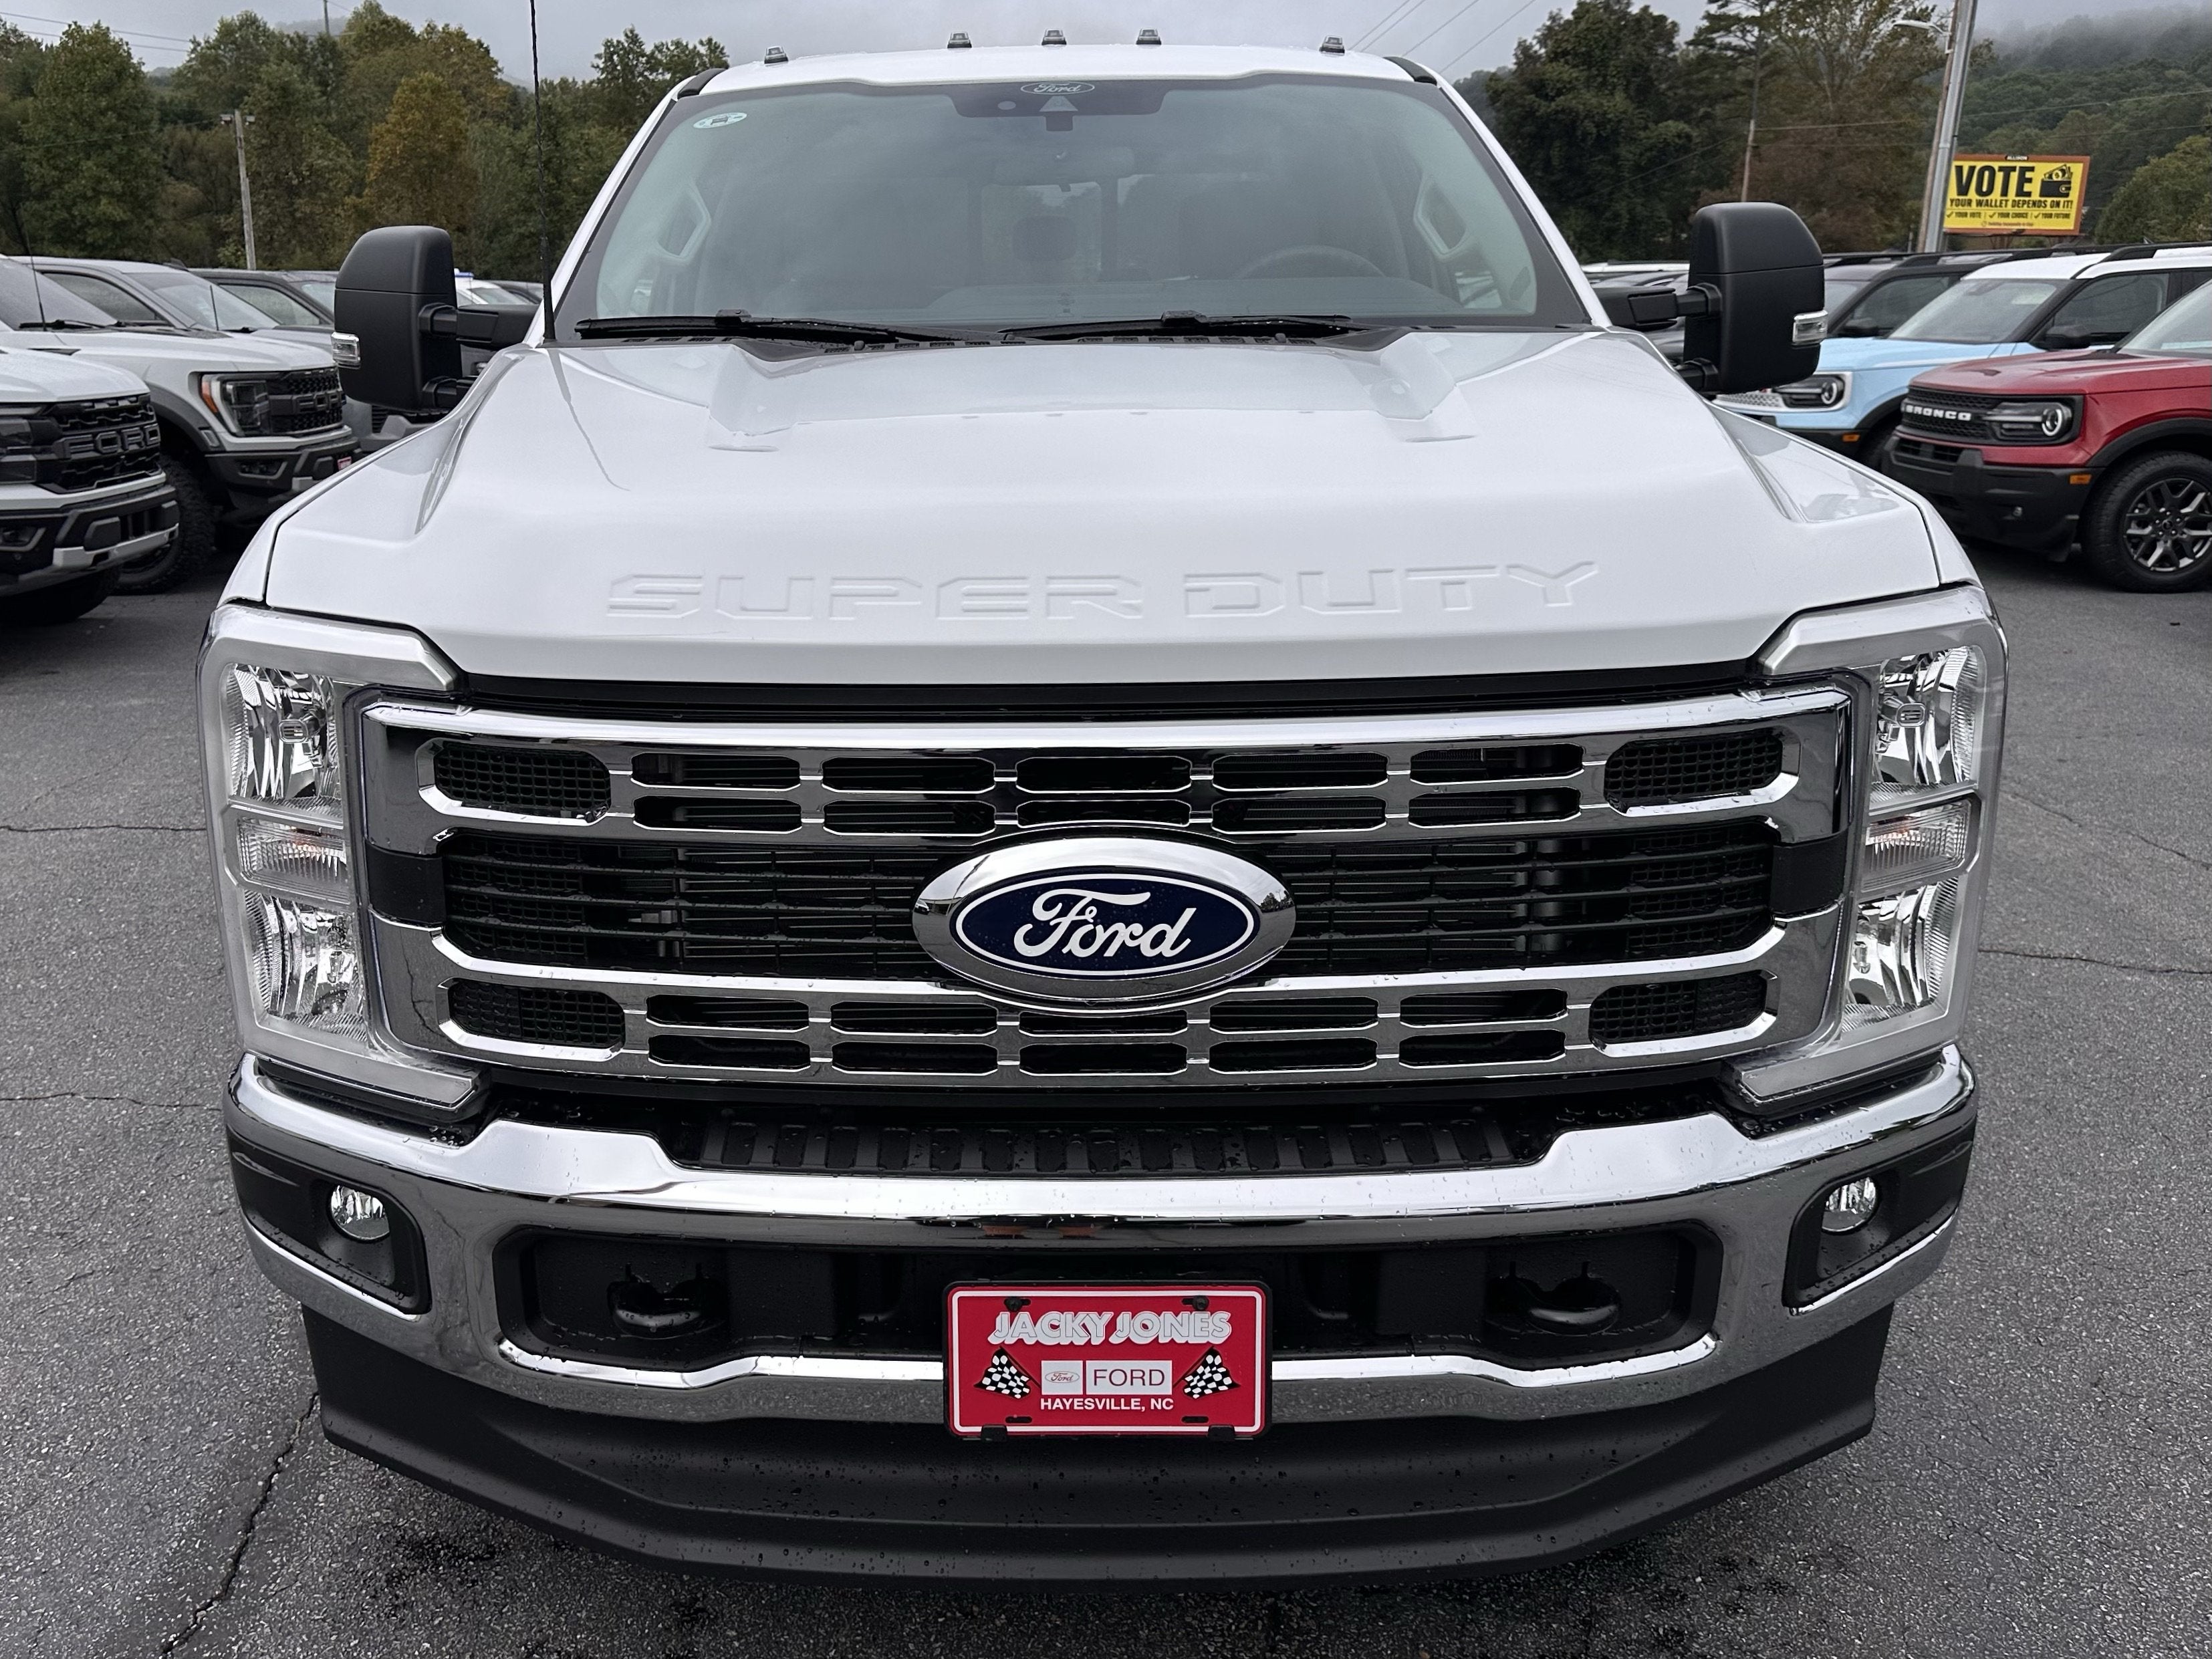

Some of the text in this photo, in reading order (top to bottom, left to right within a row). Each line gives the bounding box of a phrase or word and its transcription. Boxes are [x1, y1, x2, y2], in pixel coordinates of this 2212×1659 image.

[1033, 83, 1082, 92] Ford
[1955, 165, 2035, 197] VOTE
[1949, 199, 2073, 209] YOUR WALLET DEPENDS ON IT!
[1906, 404, 1971, 421] BRONCO
[62, 422, 161, 459] FORD
[606, 561, 1600, 621] SUPER DUTY
[1013, 888, 1197, 958] Ford
[987, 1311, 1232, 1345] JACKY JONES
[1051, 1369, 1164, 1386] Ford FORD
[1041, 1398, 1174, 1412] HAYESVILLE, NC
